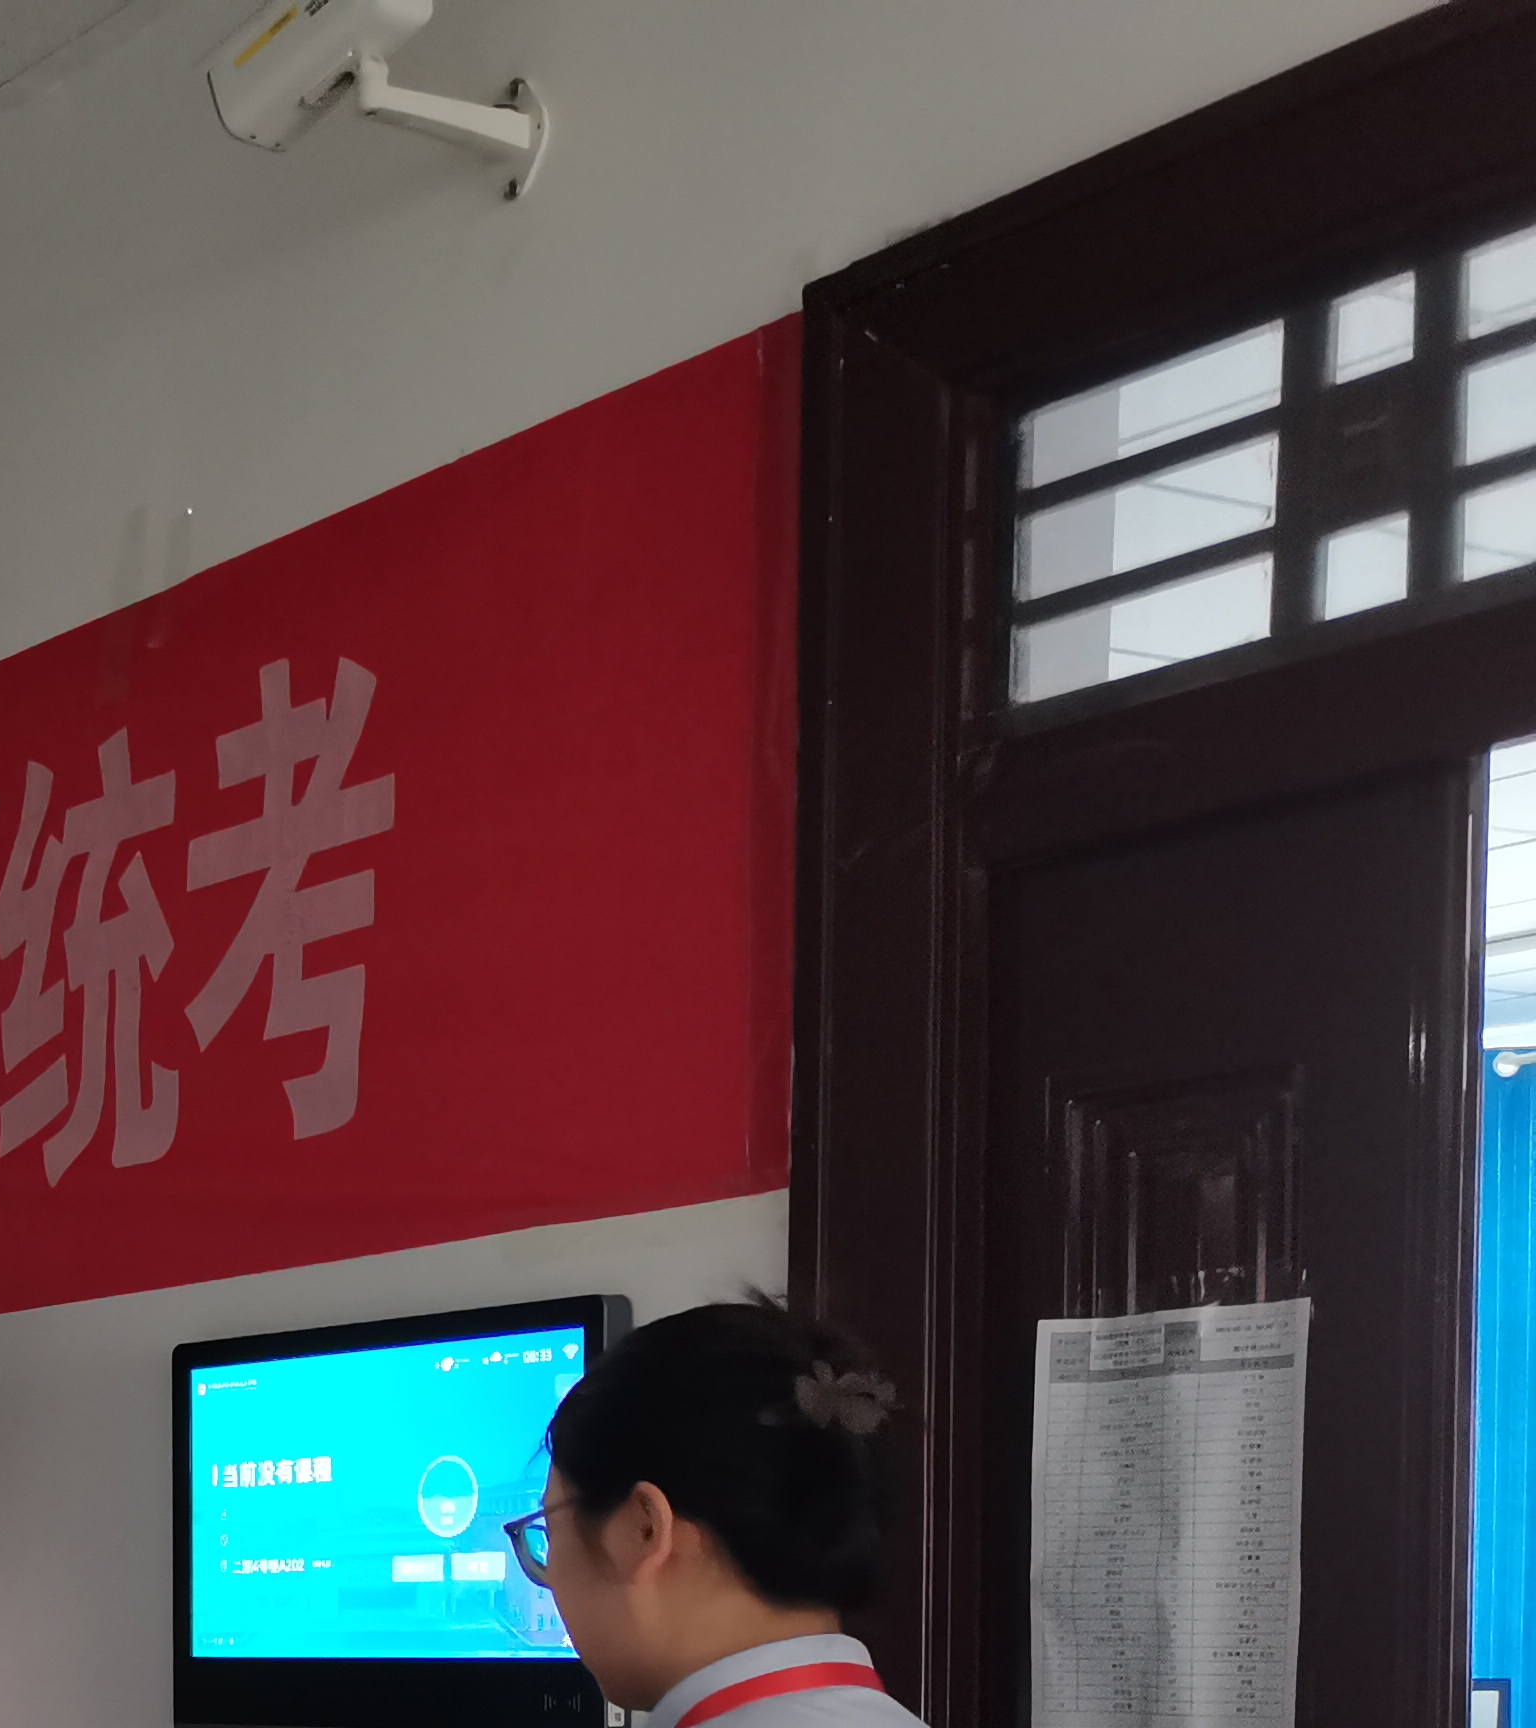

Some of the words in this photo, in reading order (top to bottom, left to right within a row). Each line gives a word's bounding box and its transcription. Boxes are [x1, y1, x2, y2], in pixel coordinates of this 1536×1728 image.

[222, 1456, 332, 1488] 当前没有课程
